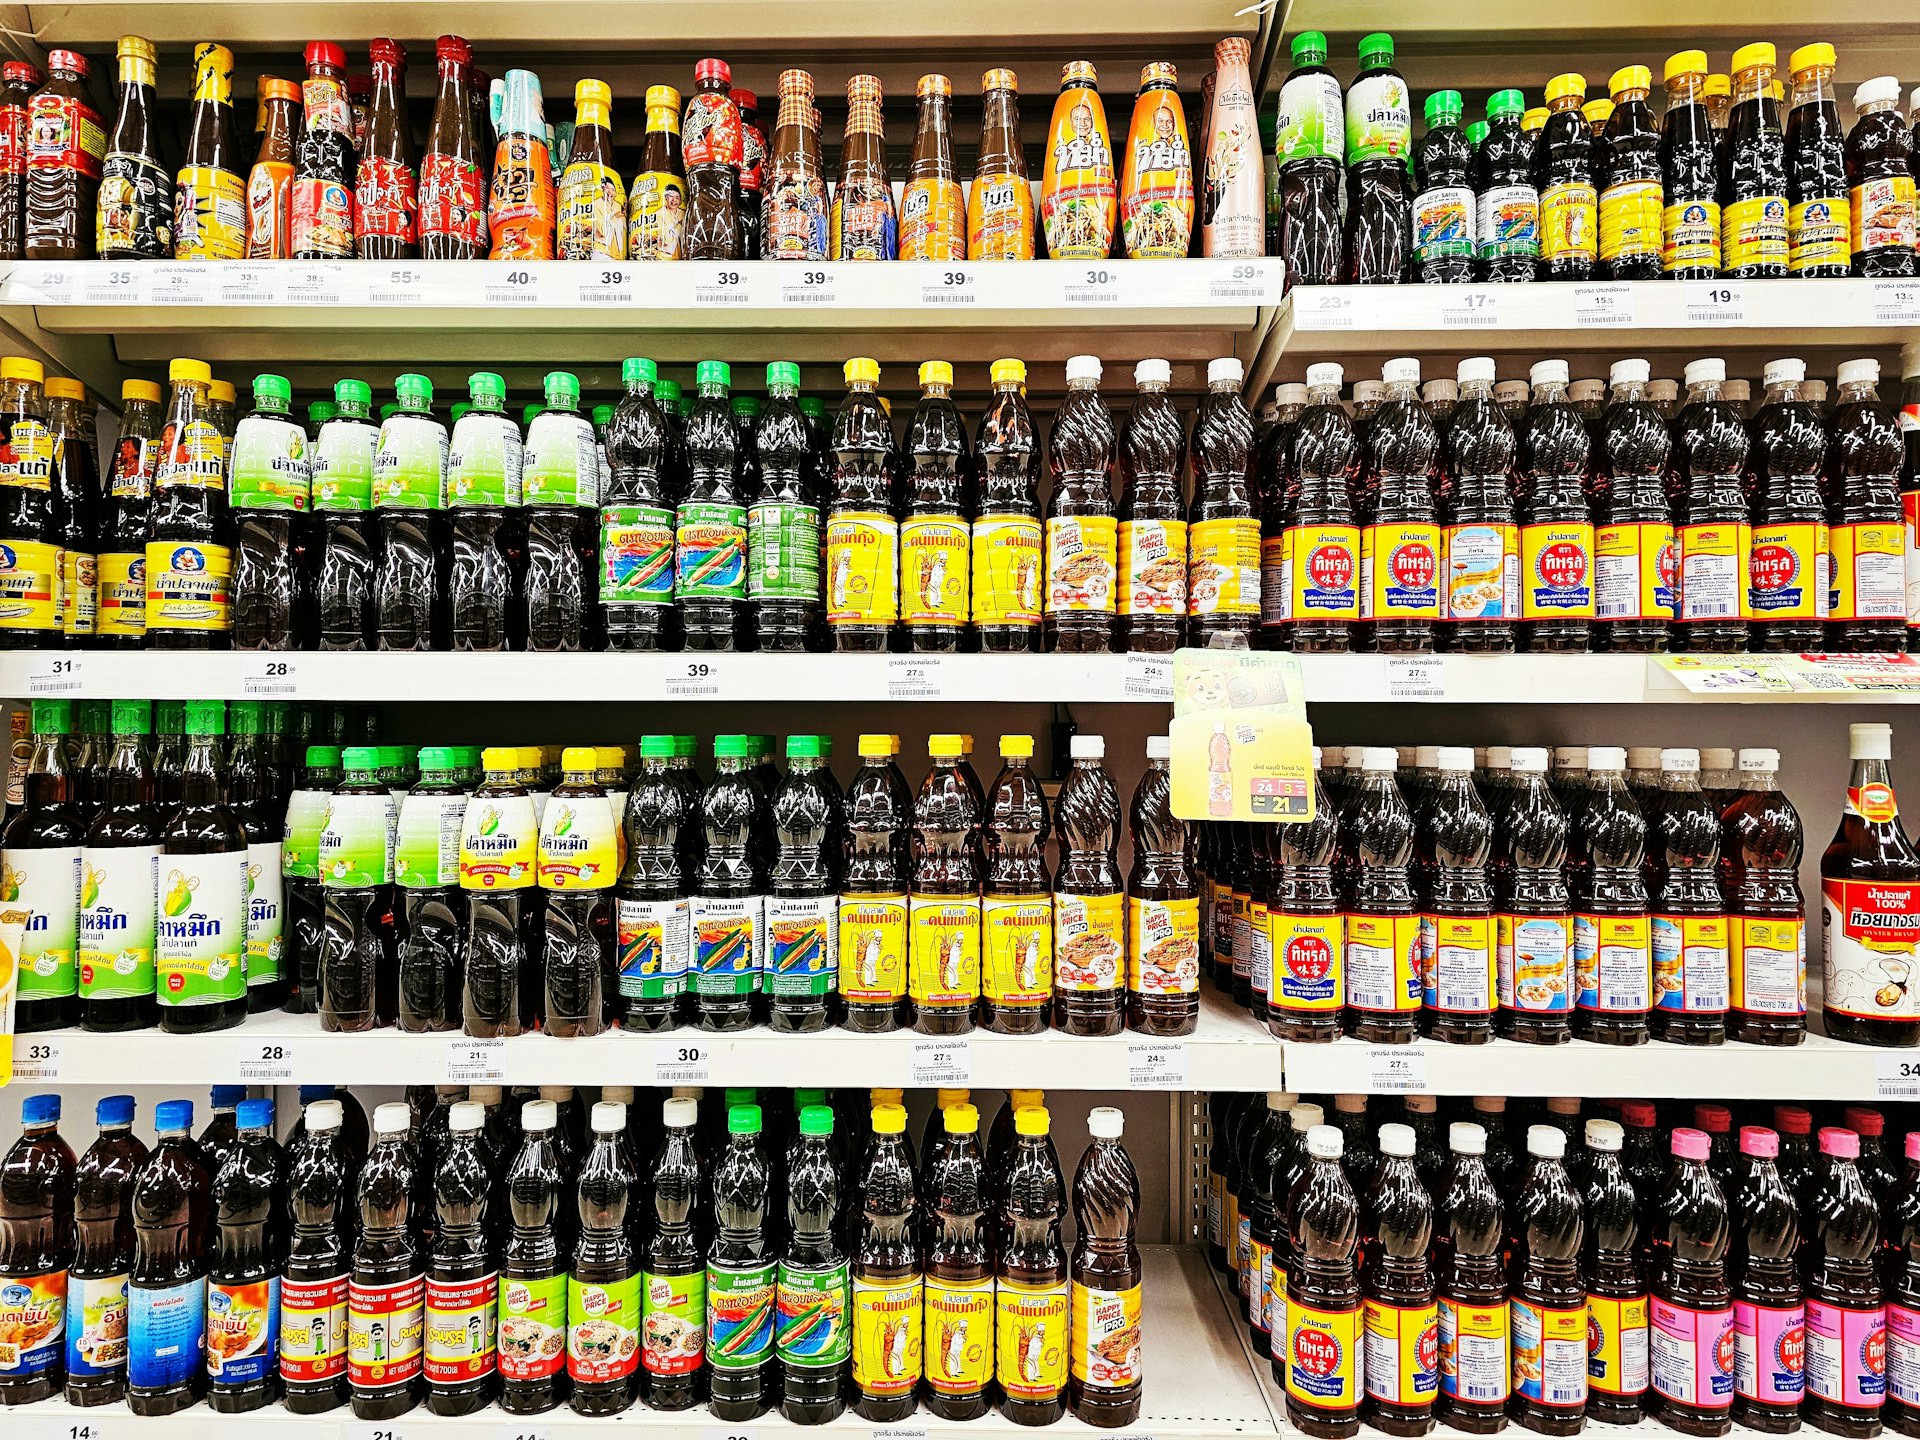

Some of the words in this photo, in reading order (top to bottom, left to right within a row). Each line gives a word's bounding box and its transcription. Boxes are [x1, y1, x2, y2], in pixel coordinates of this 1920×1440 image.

[109, 271, 131, 284] 35
[390, 271, 412, 283] 55
[507, 271, 529, 284] 40
[601, 271, 623, 284] 39
[718, 272, 739, 284] 39
[804, 272, 825, 284] 39
[944, 272, 965, 284] 39
[1086, 271, 1108, 284] 30
[1232, 266, 1254, 278] 59
[1320, 296, 1341, 308] 23
[1465, 295, 1486, 307] 17
[1709, 290, 1731, 303] 19
[1056, 528, 1079, 542] HAPPY
[1138, 532, 1163, 546] HAPPY
[1057, 534, 1080, 550] PRICE
[1140, 539, 1165, 552] PRICE
[1062, 543, 1083, 557] PRO
[1147, 548, 1168, 561] PRO
[1315, 554, 1350, 572] ทิพรส
[1398, 553, 1432, 570] ทิพรส
[1545, 554, 1583, 571] ทิพรส
[53, 660, 71, 673] 31
[266, 663, 287, 676] 28
[688, 665, 709, 676] 39
[1145, 667, 1156, 675] 24
[1257, 783, 1273, 793] 24
[1285, 783, 1293, 794] 3
[1272, 796, 1290, 812] 21
[466, 833, 518, 850] ปลาหมึก
[1875, 899, 1907, 910] 100%
[1060, 908, 1084, 920] HAPPY
[1145, 912, 1167, 926] HAPPY
[1061, 915, 1085, 927] PRICE
[1146, 919, 1169, 932] PRICE
[1067, 922, 1088, 936] PRO
[1153, 927, 1174, 941] PRO
[1863, 929, 1892, 937] OYSTER
[1893, 929, 1915, 938] BRAND
[1290, 944, 1327, 963] ทิพรส
[30, 1045, 51, 1058] 33
[262, 1046, 283, 1059] 28
[678, 1048, 699, 1061] 30
[934, 1053, 944, 1061] 27
[1900, 1064, 1920, 1076] 34
[507, 1288, 528, 1300] HAPPY
[651, 1284, 670, 1296] HAPPY
[652, 1291, 670, 1302] PRICE
[508, 1295, 530, 1307] PRICE
[584, 1291, 606, 1304] HAPPY
[585, 1298, 608, 1311] PRICE
[1094, 1302, 1121, 1317] HAPPY
[1096, 1309, 1122, 1325] PRICE
[1104, 1316, 1126, 1334] PRO
[1299, 1335, 1336, 1360] ทิพรส
[70, 1426, 89, 1439] 14
